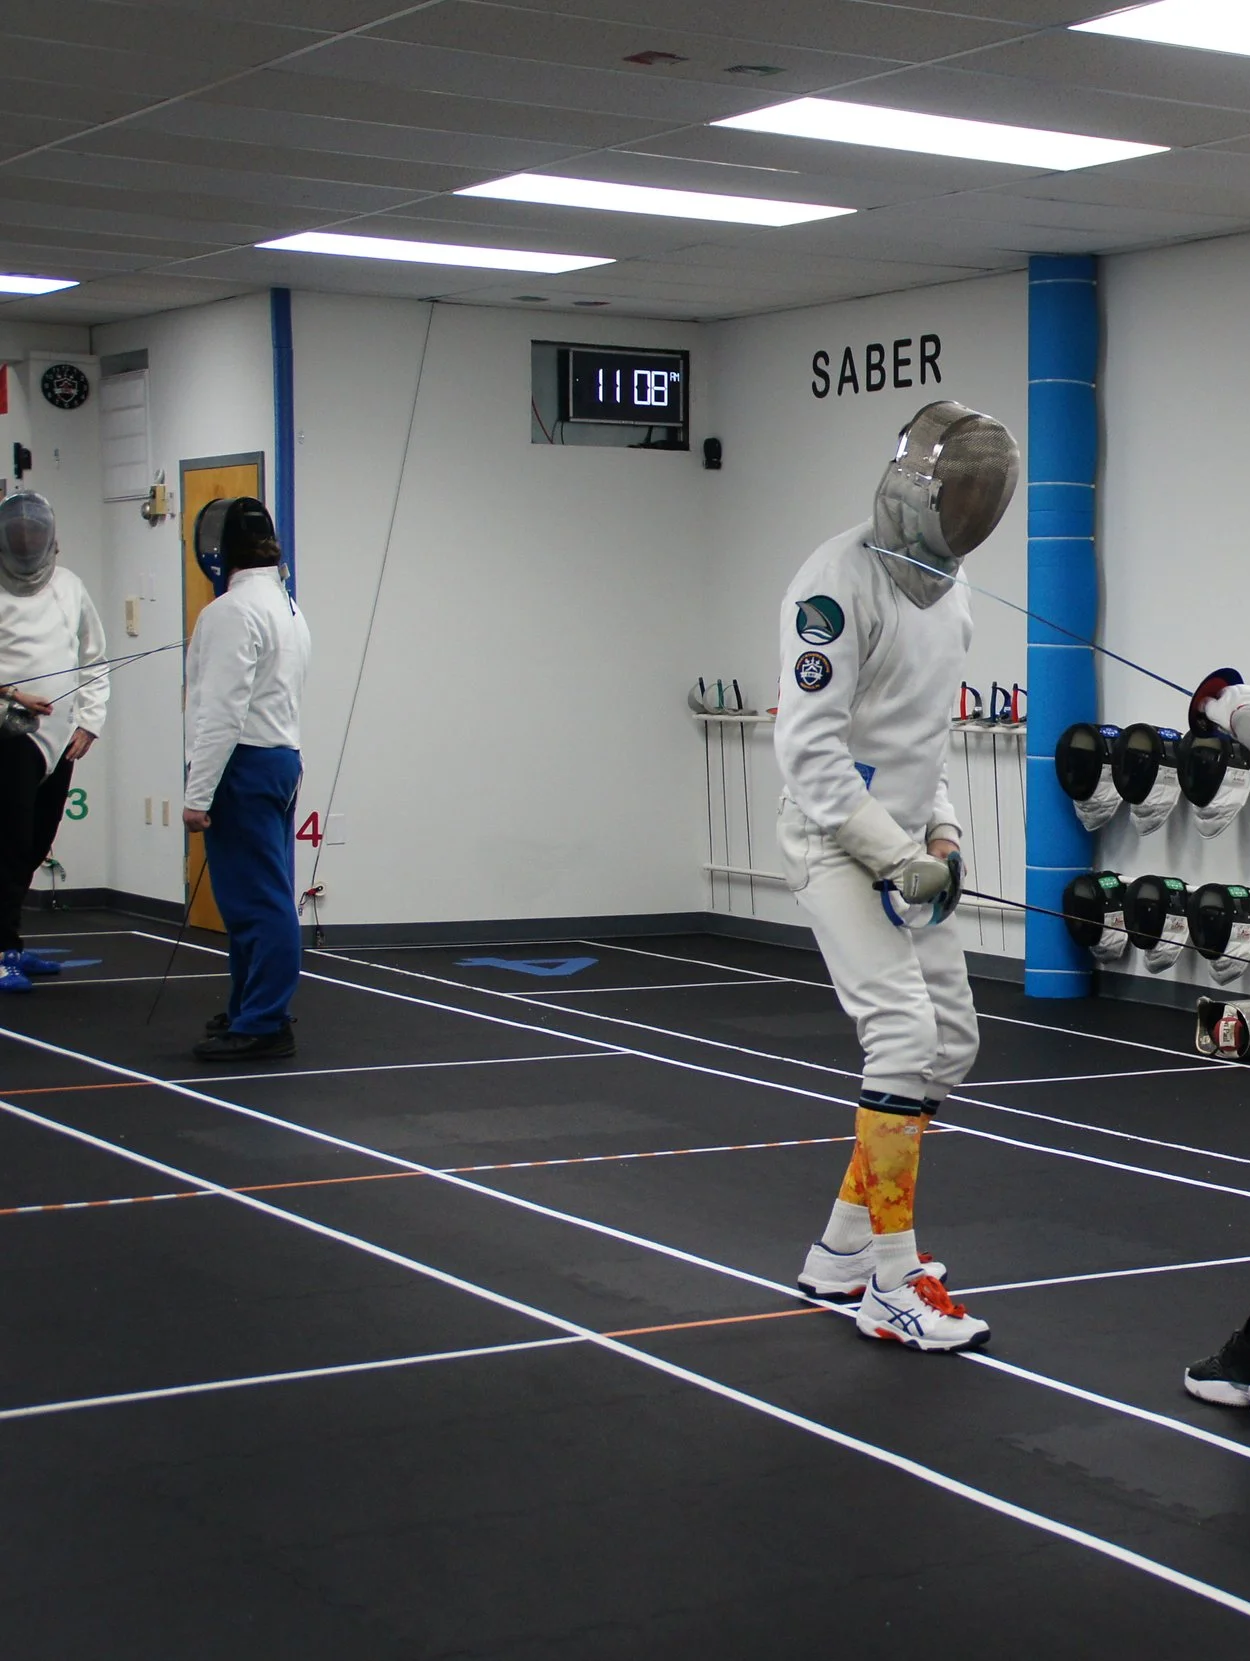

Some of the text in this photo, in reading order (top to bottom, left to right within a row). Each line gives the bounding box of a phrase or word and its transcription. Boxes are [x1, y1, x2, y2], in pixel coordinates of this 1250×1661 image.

[811, 333, 942, 399] SABER
[65, 788, 89, 820] 3
[296, 811, 323, 848] 4
